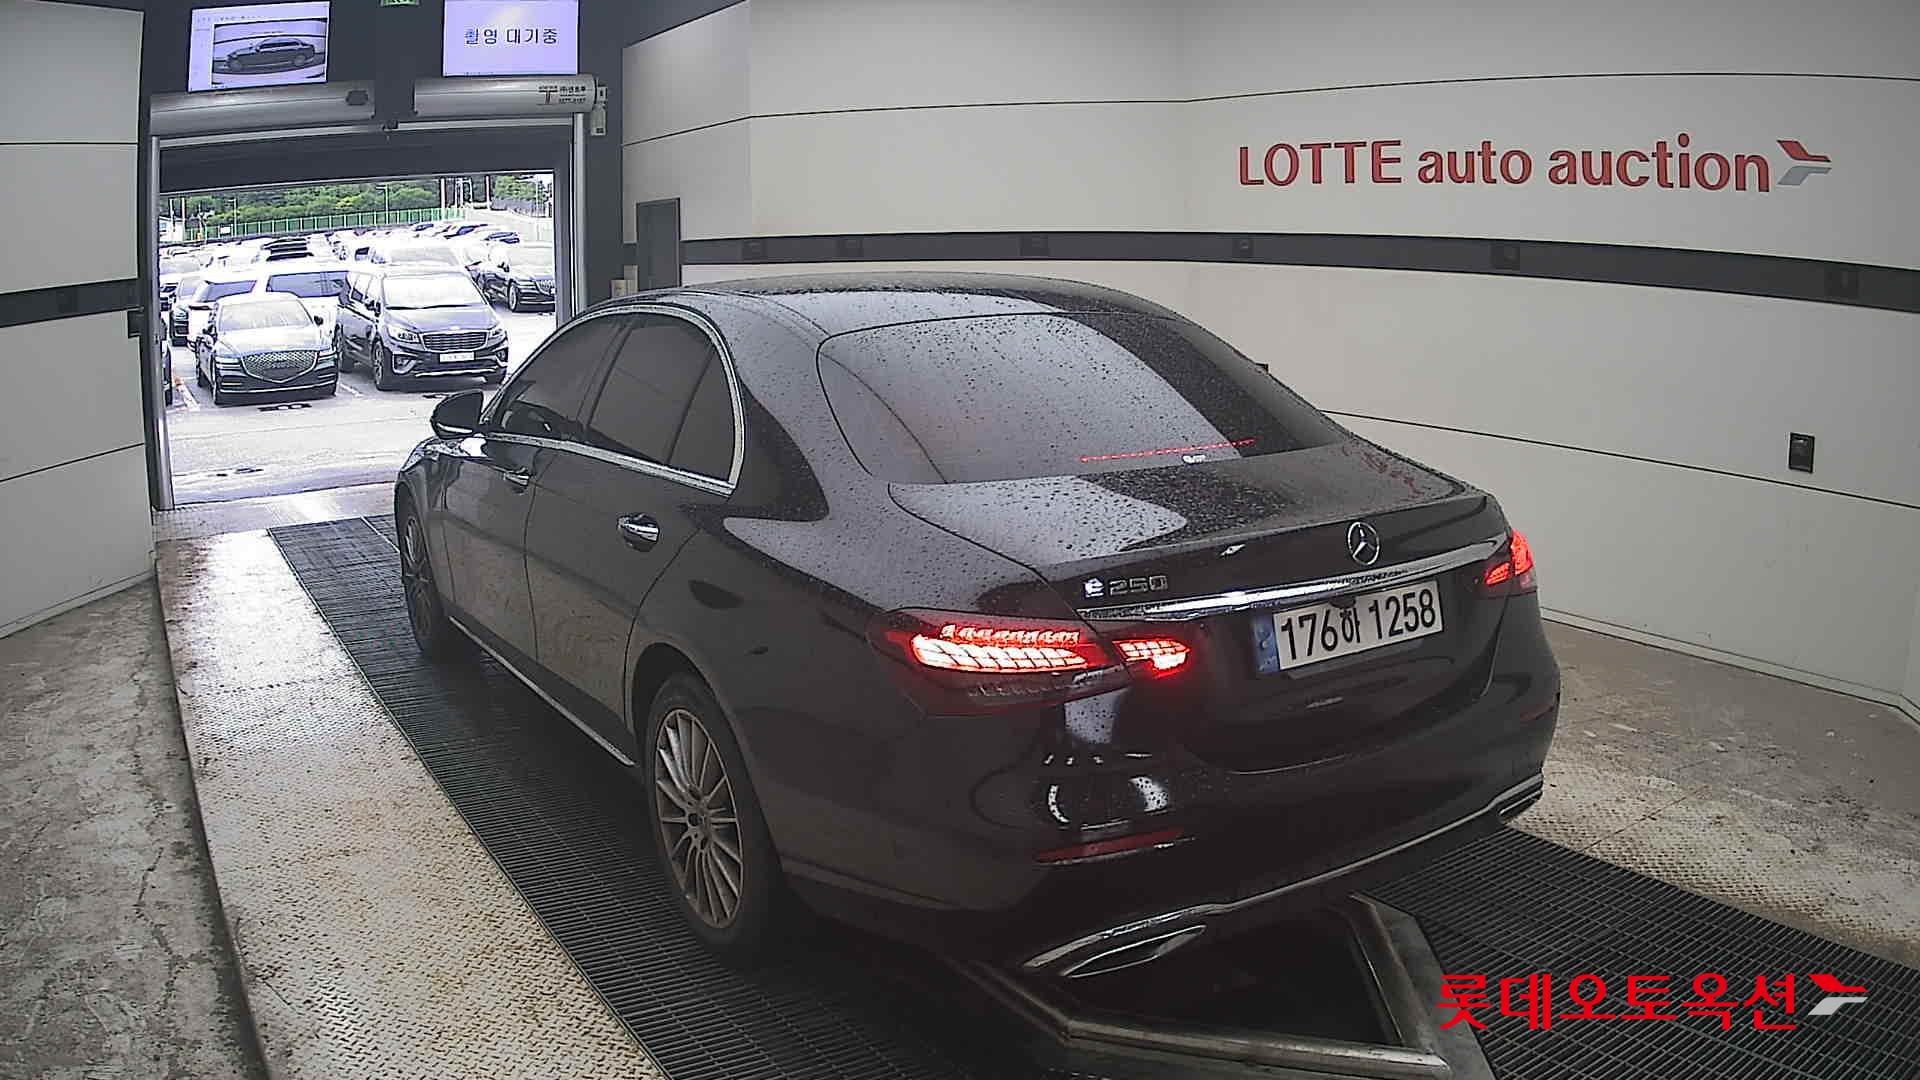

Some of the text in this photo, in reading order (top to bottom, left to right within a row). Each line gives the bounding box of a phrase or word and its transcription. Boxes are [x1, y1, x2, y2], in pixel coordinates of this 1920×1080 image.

[506, 28, 558, 45] 대기중
[1239, 133, 1771, 193] LOTTE auto auction
[1109, 575, 1168, 596] 250
[1281, 588, 1437, 661] 176하 1258
